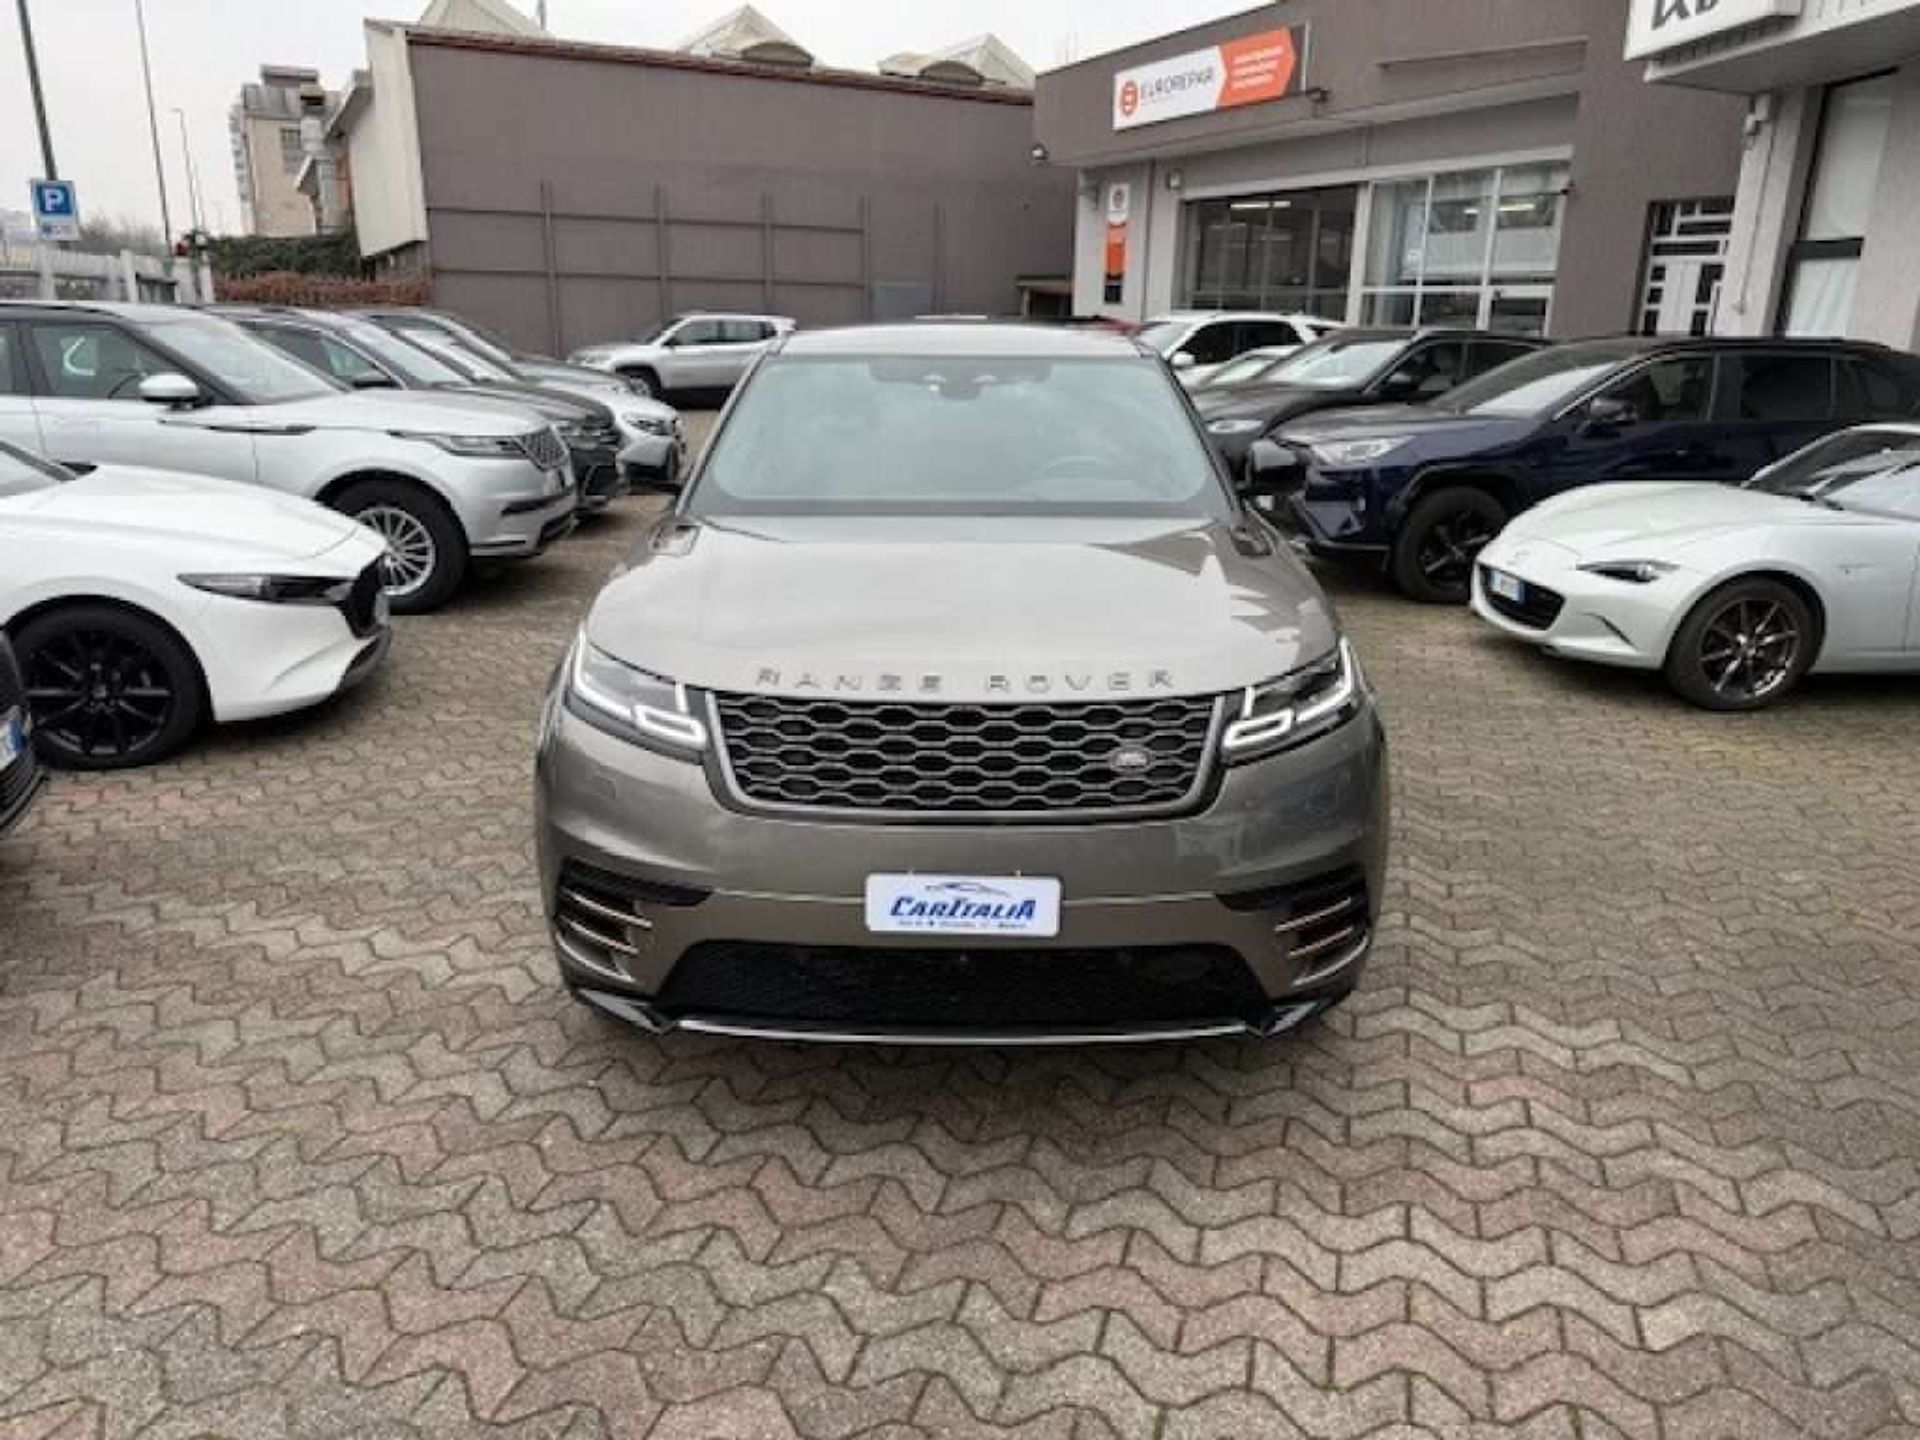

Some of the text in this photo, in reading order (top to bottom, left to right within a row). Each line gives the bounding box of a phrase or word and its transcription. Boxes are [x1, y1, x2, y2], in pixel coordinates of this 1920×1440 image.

[44, 188, 65, 212] P
[757, 668, 1175, 692] RANGE ROVER
